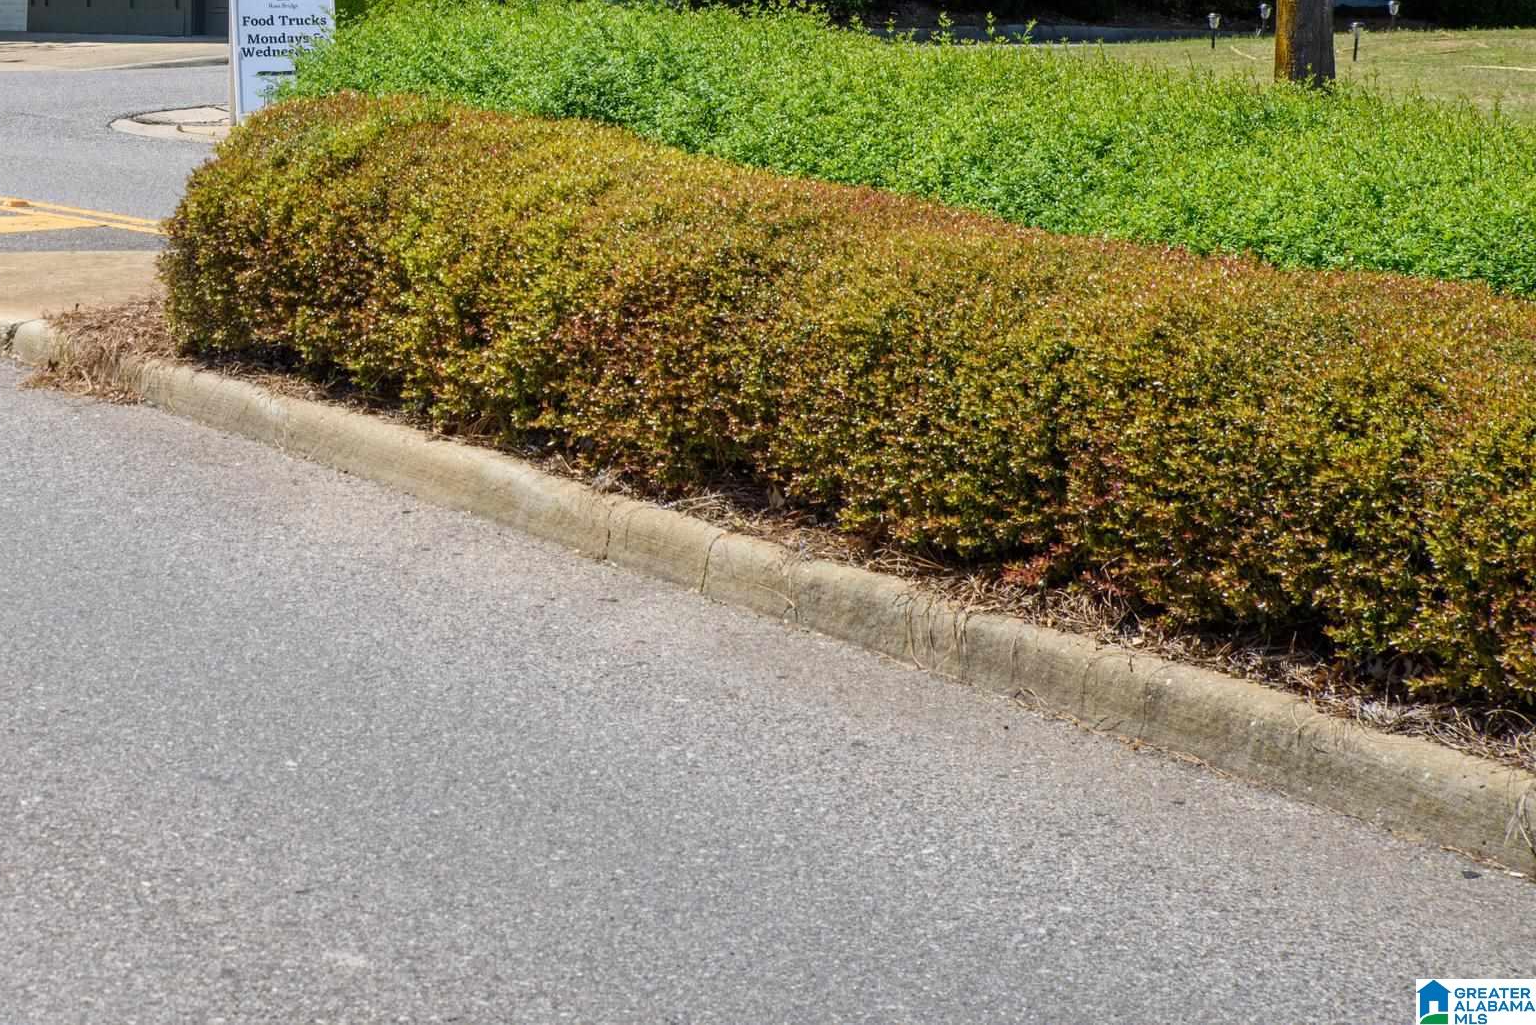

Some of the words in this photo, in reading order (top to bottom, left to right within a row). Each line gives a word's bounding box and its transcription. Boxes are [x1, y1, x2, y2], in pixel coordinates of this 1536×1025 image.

[242, 15, 275, 27] Food
[278, 14, 327, 27] Trucks
[247, 32, 310, 46] Mondays
